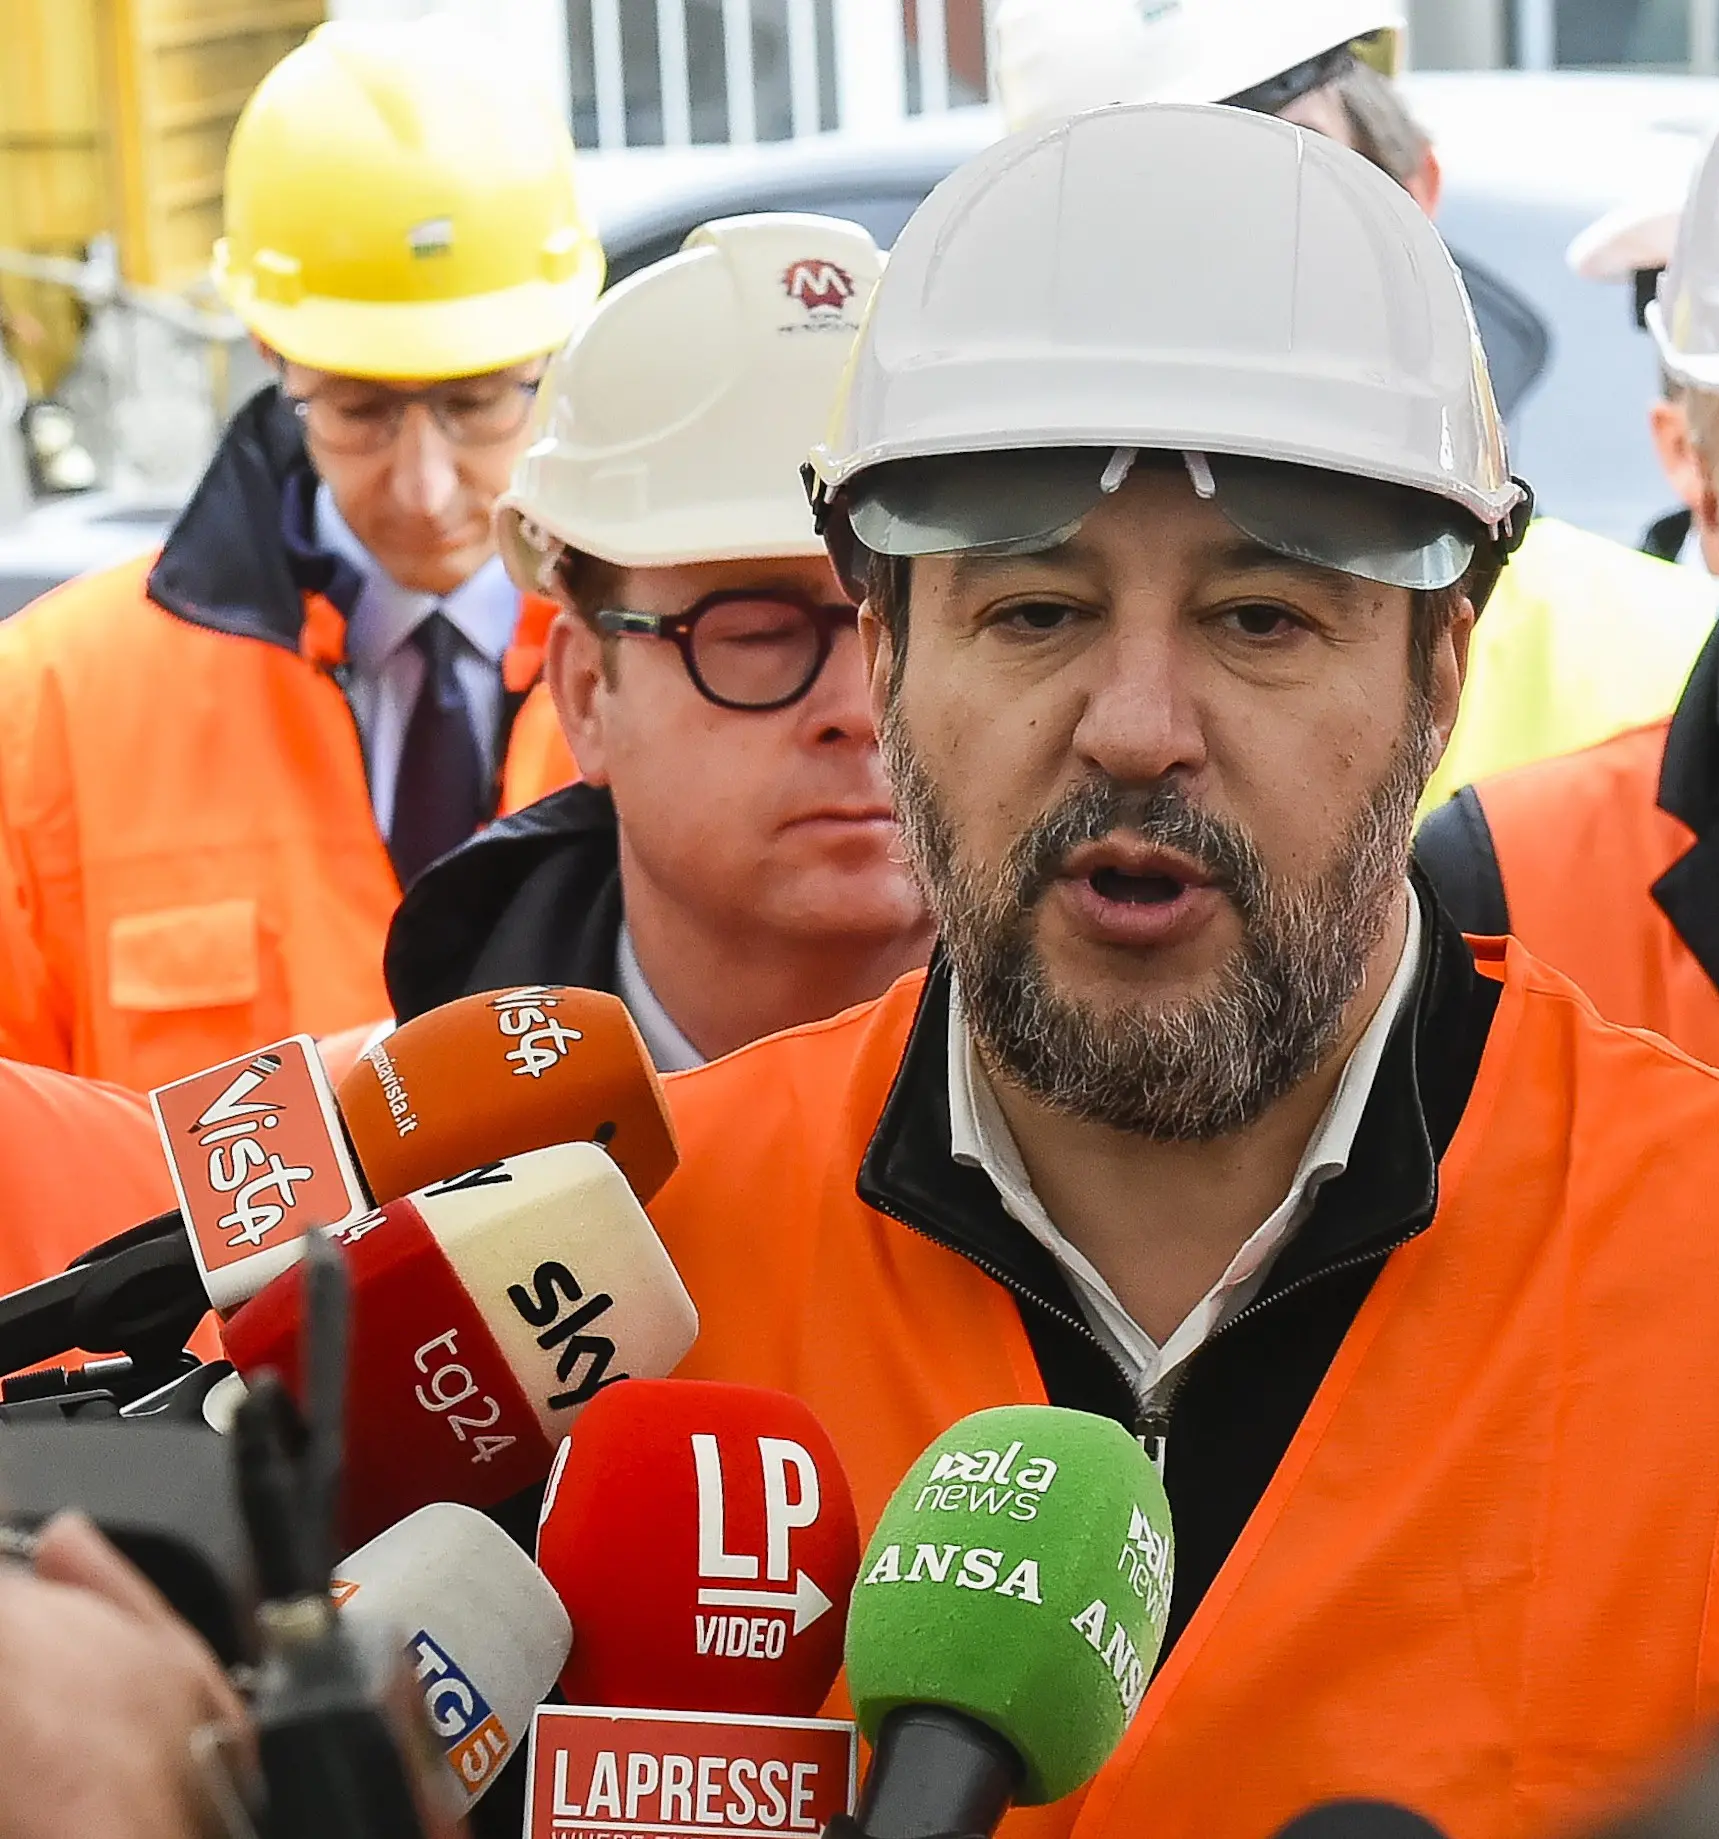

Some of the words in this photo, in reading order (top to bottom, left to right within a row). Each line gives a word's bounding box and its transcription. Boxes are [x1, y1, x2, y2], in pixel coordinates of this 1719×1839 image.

[506, 1260, 630, 1410] sky
[413, 1327, 517, 1464] tg24
[690, 1433, 820, 1581] LP
[914, 1483, 1042, 1522] news
[863, 1543, 1043, 1606] ANSA
[695, 1614, 787, 1660] VIDEO
[552, 1749, 819, 1828] LAPRESSE
